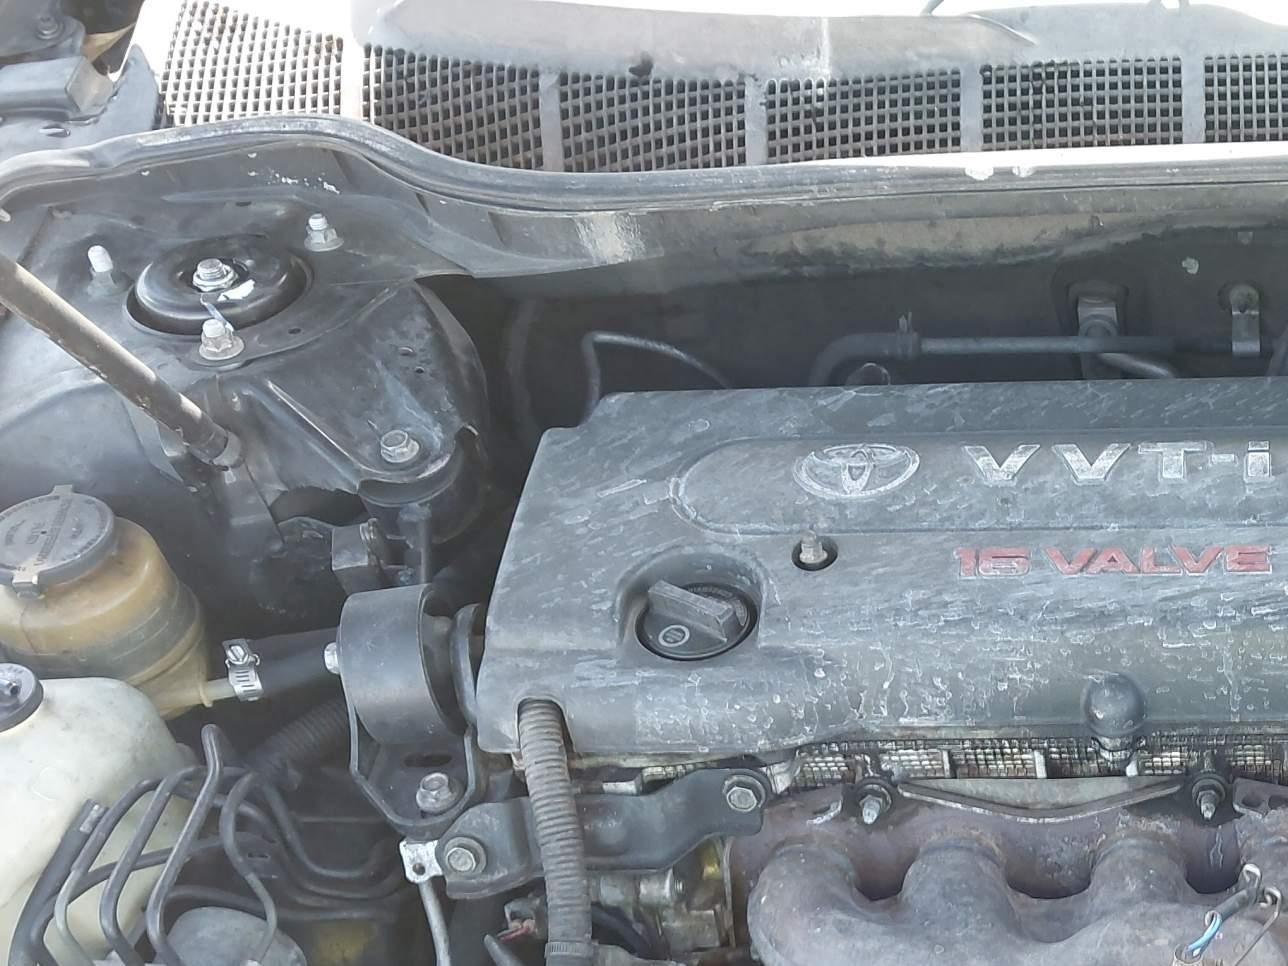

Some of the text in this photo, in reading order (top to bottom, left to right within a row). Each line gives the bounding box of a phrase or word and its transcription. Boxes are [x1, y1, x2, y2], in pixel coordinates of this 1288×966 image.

[962, 441, 1273, 484] VVT-i
[953, 544, 1273, 578] 16 VALVE
